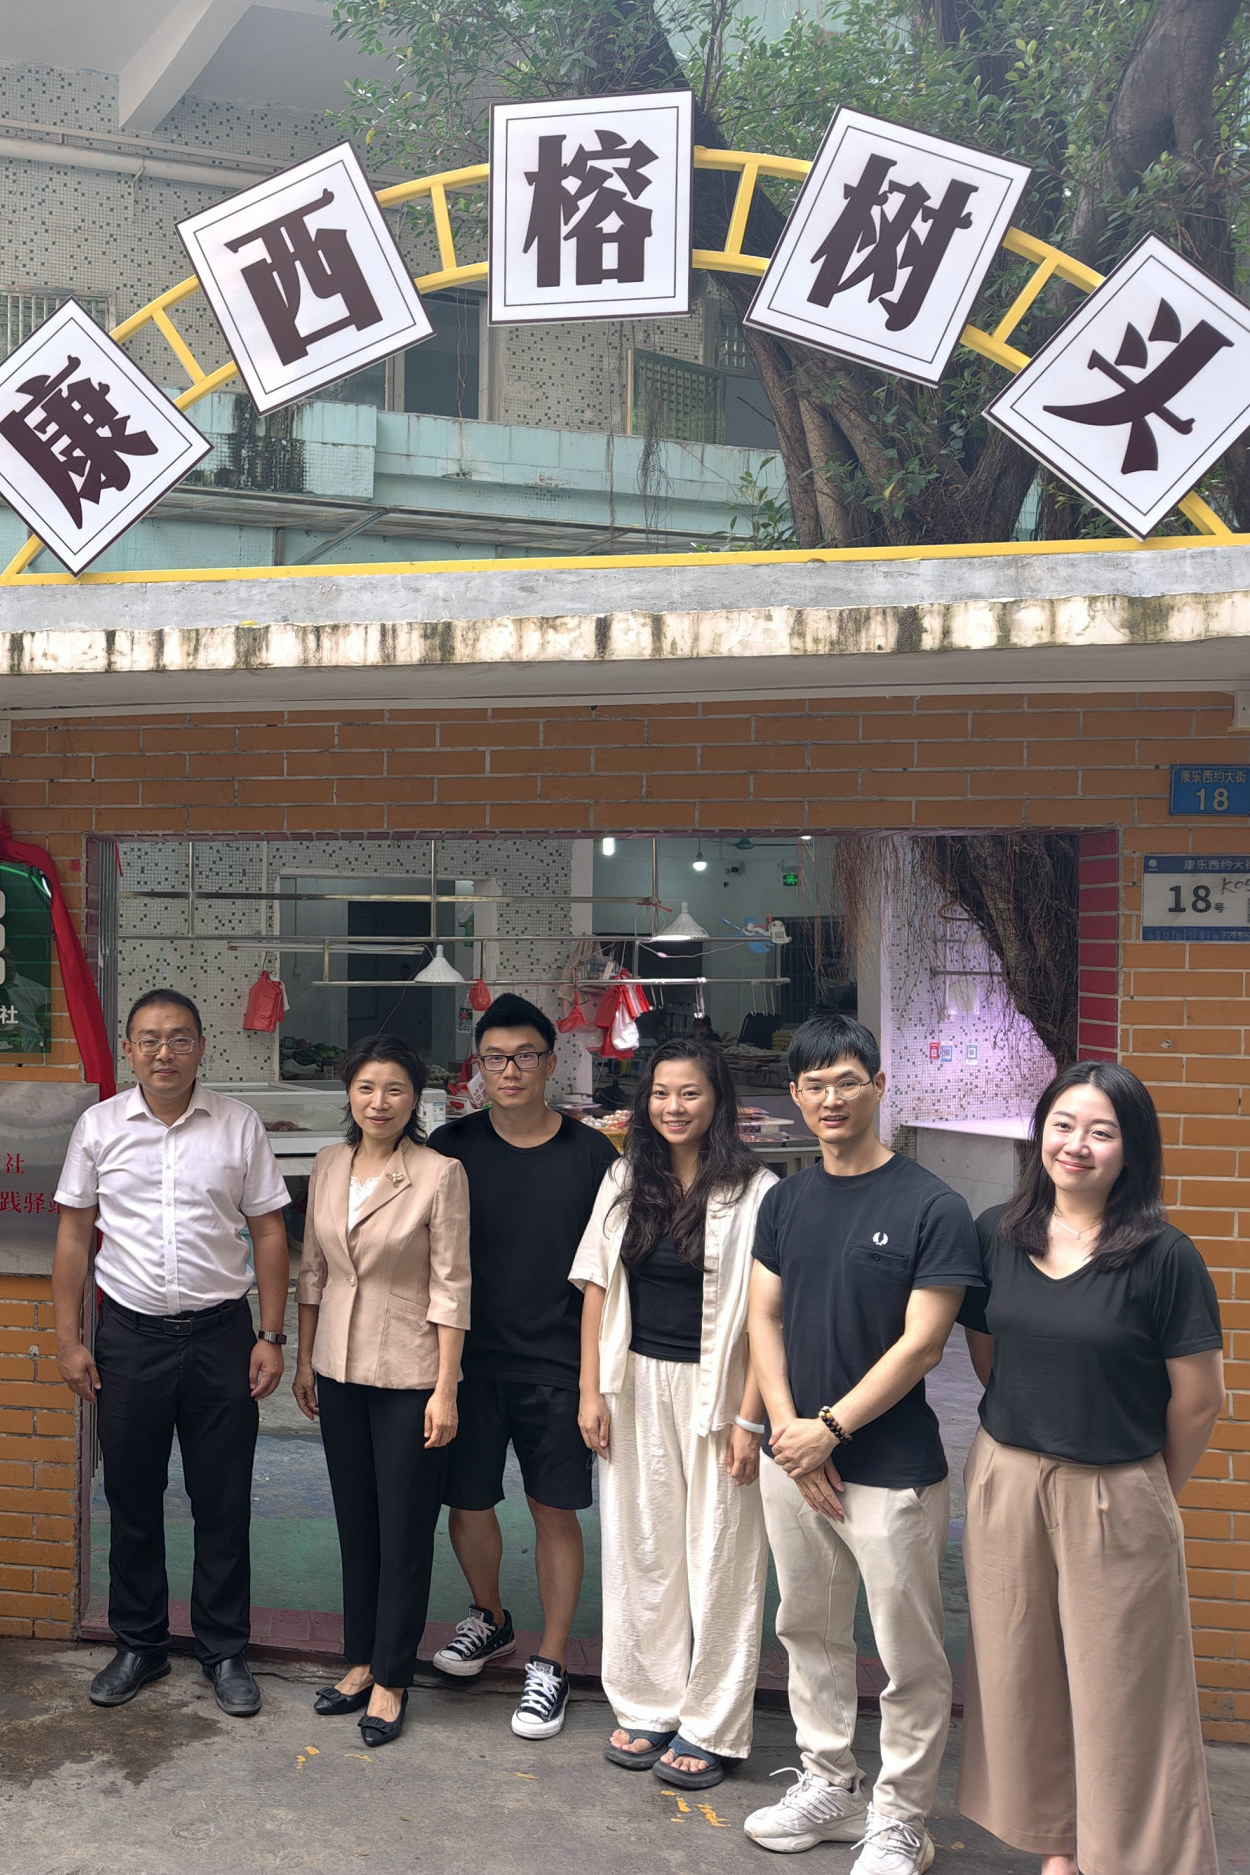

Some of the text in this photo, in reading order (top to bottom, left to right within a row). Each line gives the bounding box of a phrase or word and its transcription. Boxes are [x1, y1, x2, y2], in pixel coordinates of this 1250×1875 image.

[1181, 770, 1246, 783] 康乐西约大街
[1195, 787, 1229, 811] 18
